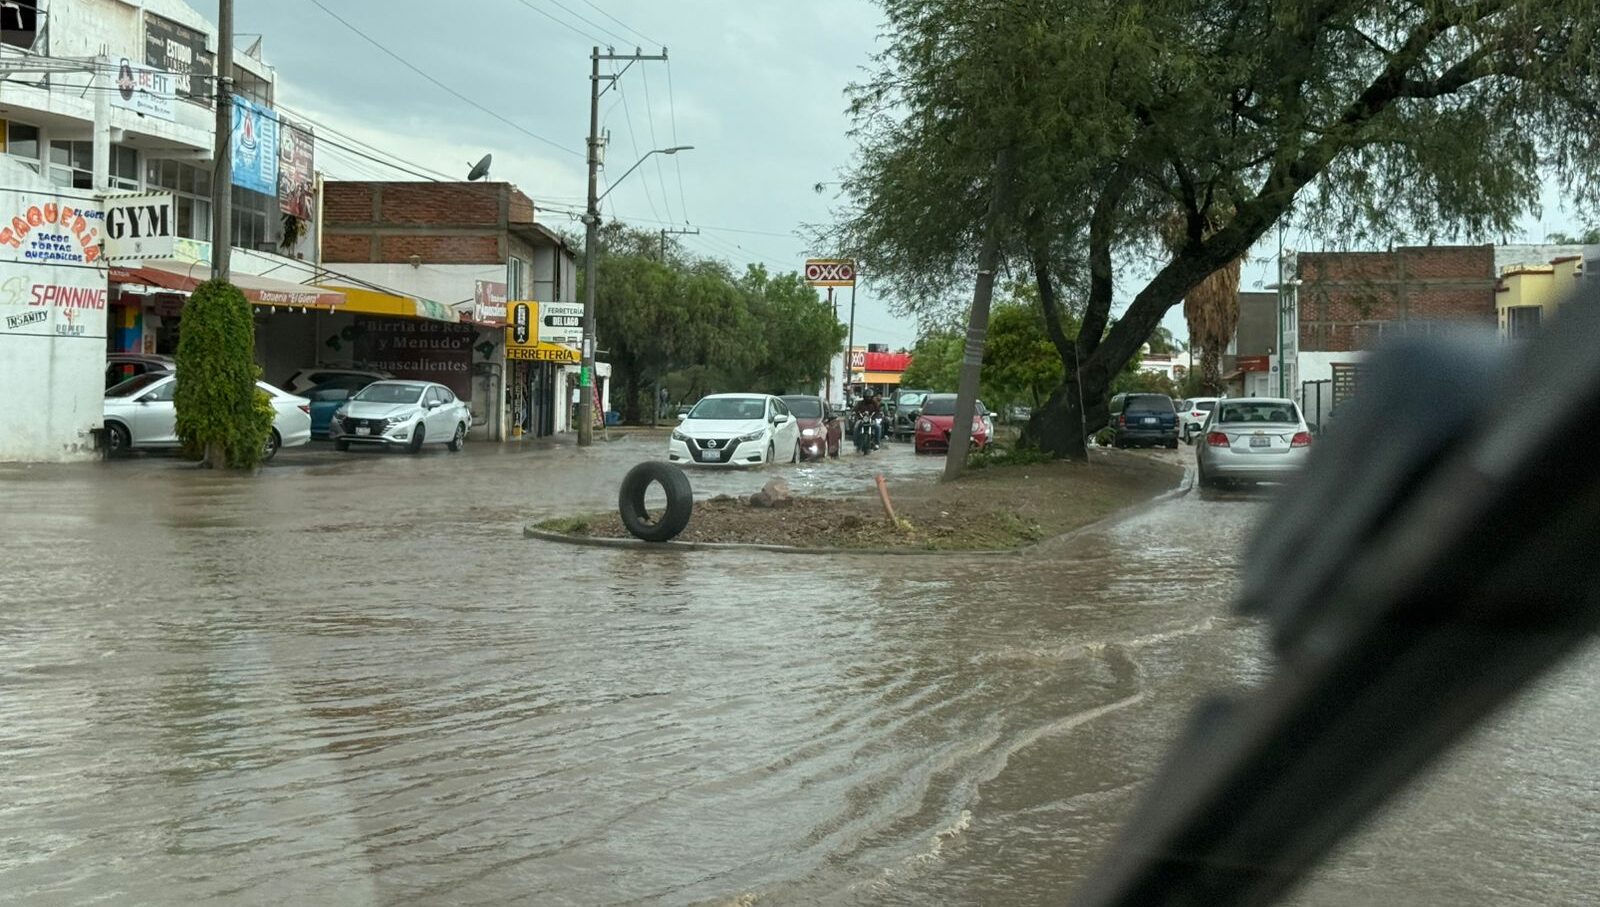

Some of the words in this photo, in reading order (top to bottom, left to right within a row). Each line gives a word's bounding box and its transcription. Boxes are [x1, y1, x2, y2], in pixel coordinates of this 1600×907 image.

[166, 39, 192, 64] ESTUDIO
[139, 69, 151, 88] BE
[153, 72, 168, 93] FIT
[74, 208, 83, 218] EL
[106, 204, 170, 240] GYM
[38, 233, 70, 243] TACOS
[32, 242, 72, 252] TORTAS
[807, 264, 853, 280] OXXO
[28, 284, 107, 310] SPINNING
[547, 306, 584, 315] FERRETERÍA
[7, 310, 48, 328] INSANITY
[552, 316, 563, 326] DEL
[563, 317, 579, 326] LAGO
[420, 320, 438, 333] de
[443, 321, 470, 333] Res
[506, 349, 574, 360] FERRETERÍA
[850, 351, 865, 367] XXO
[364, 358, 468, 371] uascalientes
